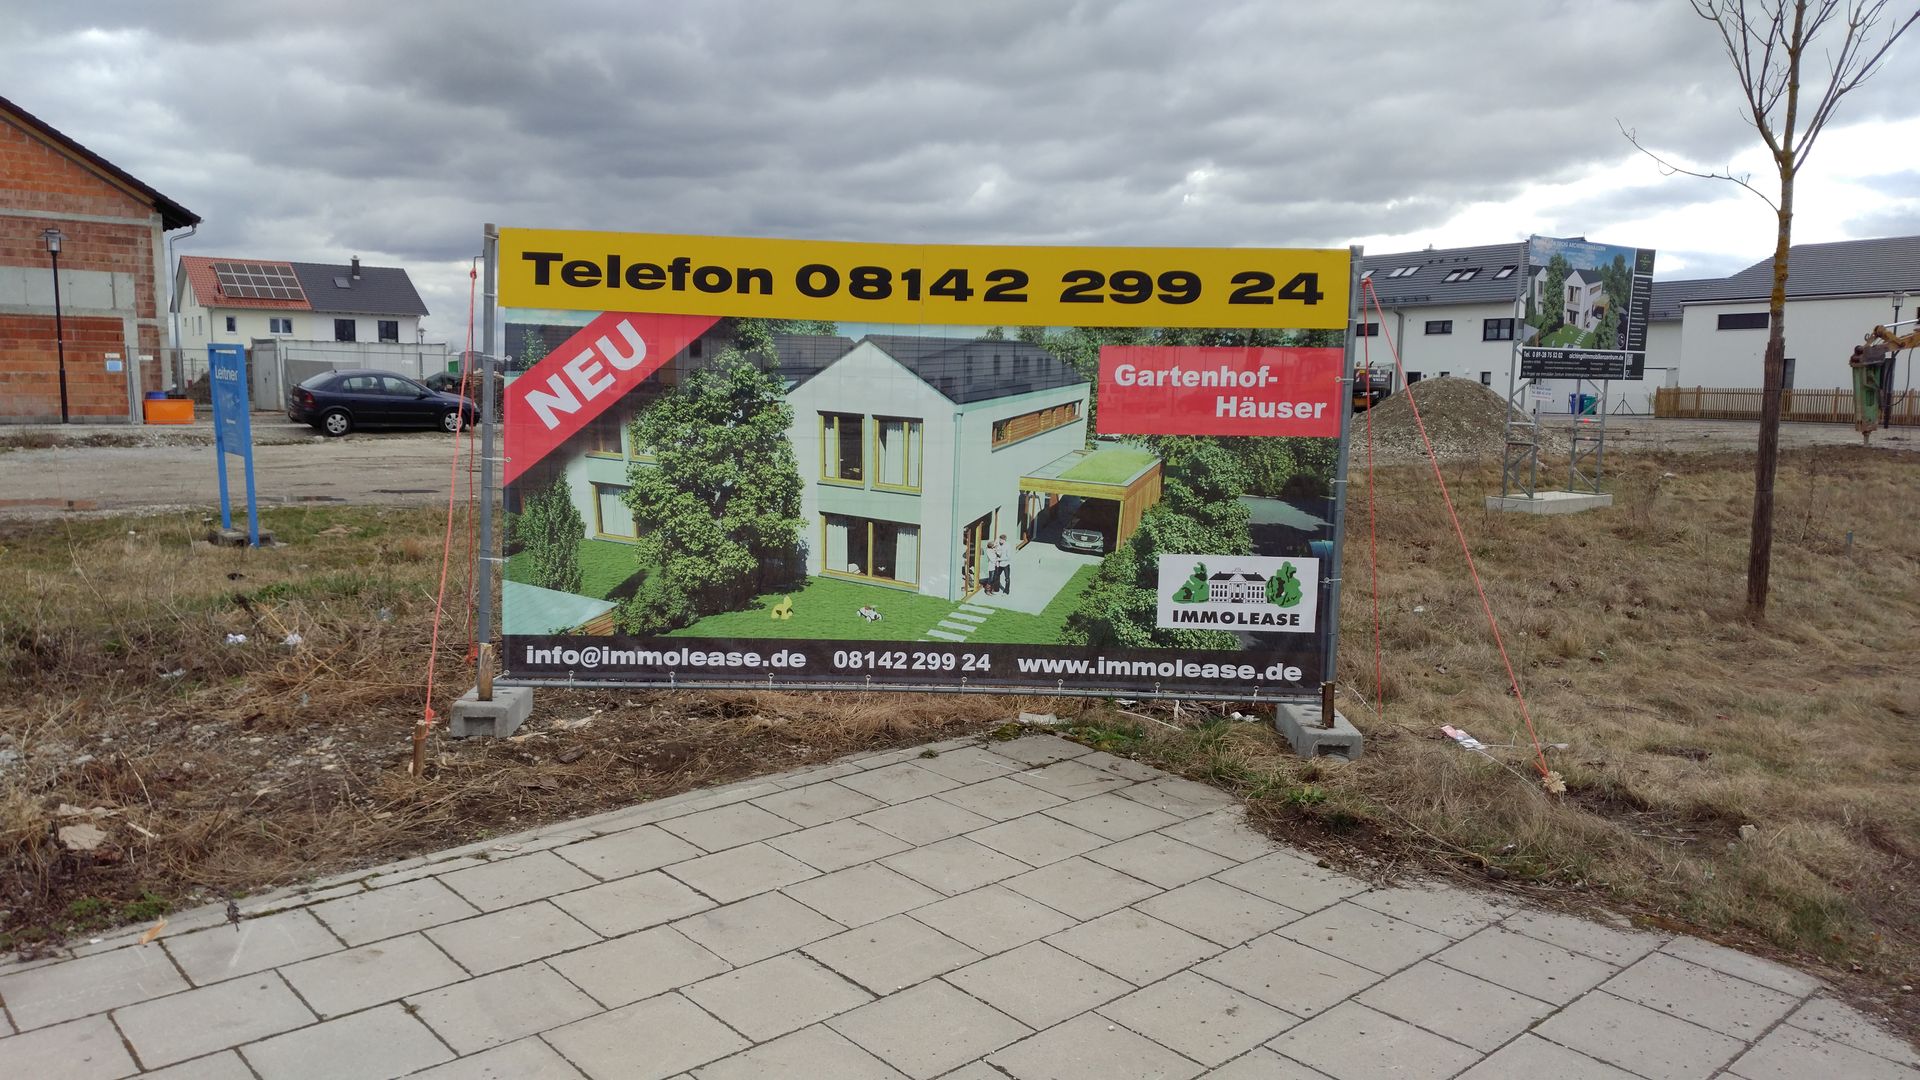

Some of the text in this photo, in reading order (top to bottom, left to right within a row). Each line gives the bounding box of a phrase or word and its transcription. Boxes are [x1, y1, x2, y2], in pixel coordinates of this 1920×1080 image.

[522, 251, 1324, 306] Telefon 08142 299 24
[524, 318, 647, 431] NEU
[1114, 364, 1279, 389] Gartenhof-
[1216, 396, 1328, 420] Häuser
[1172, 609, 1300, 627] IMMOLEASE
[525, 644, 807, 670] info@immolease.de
[833, 650, 992, 673] 08142 299 24
[1017, 656, 1303, 682] www.immolease.de
